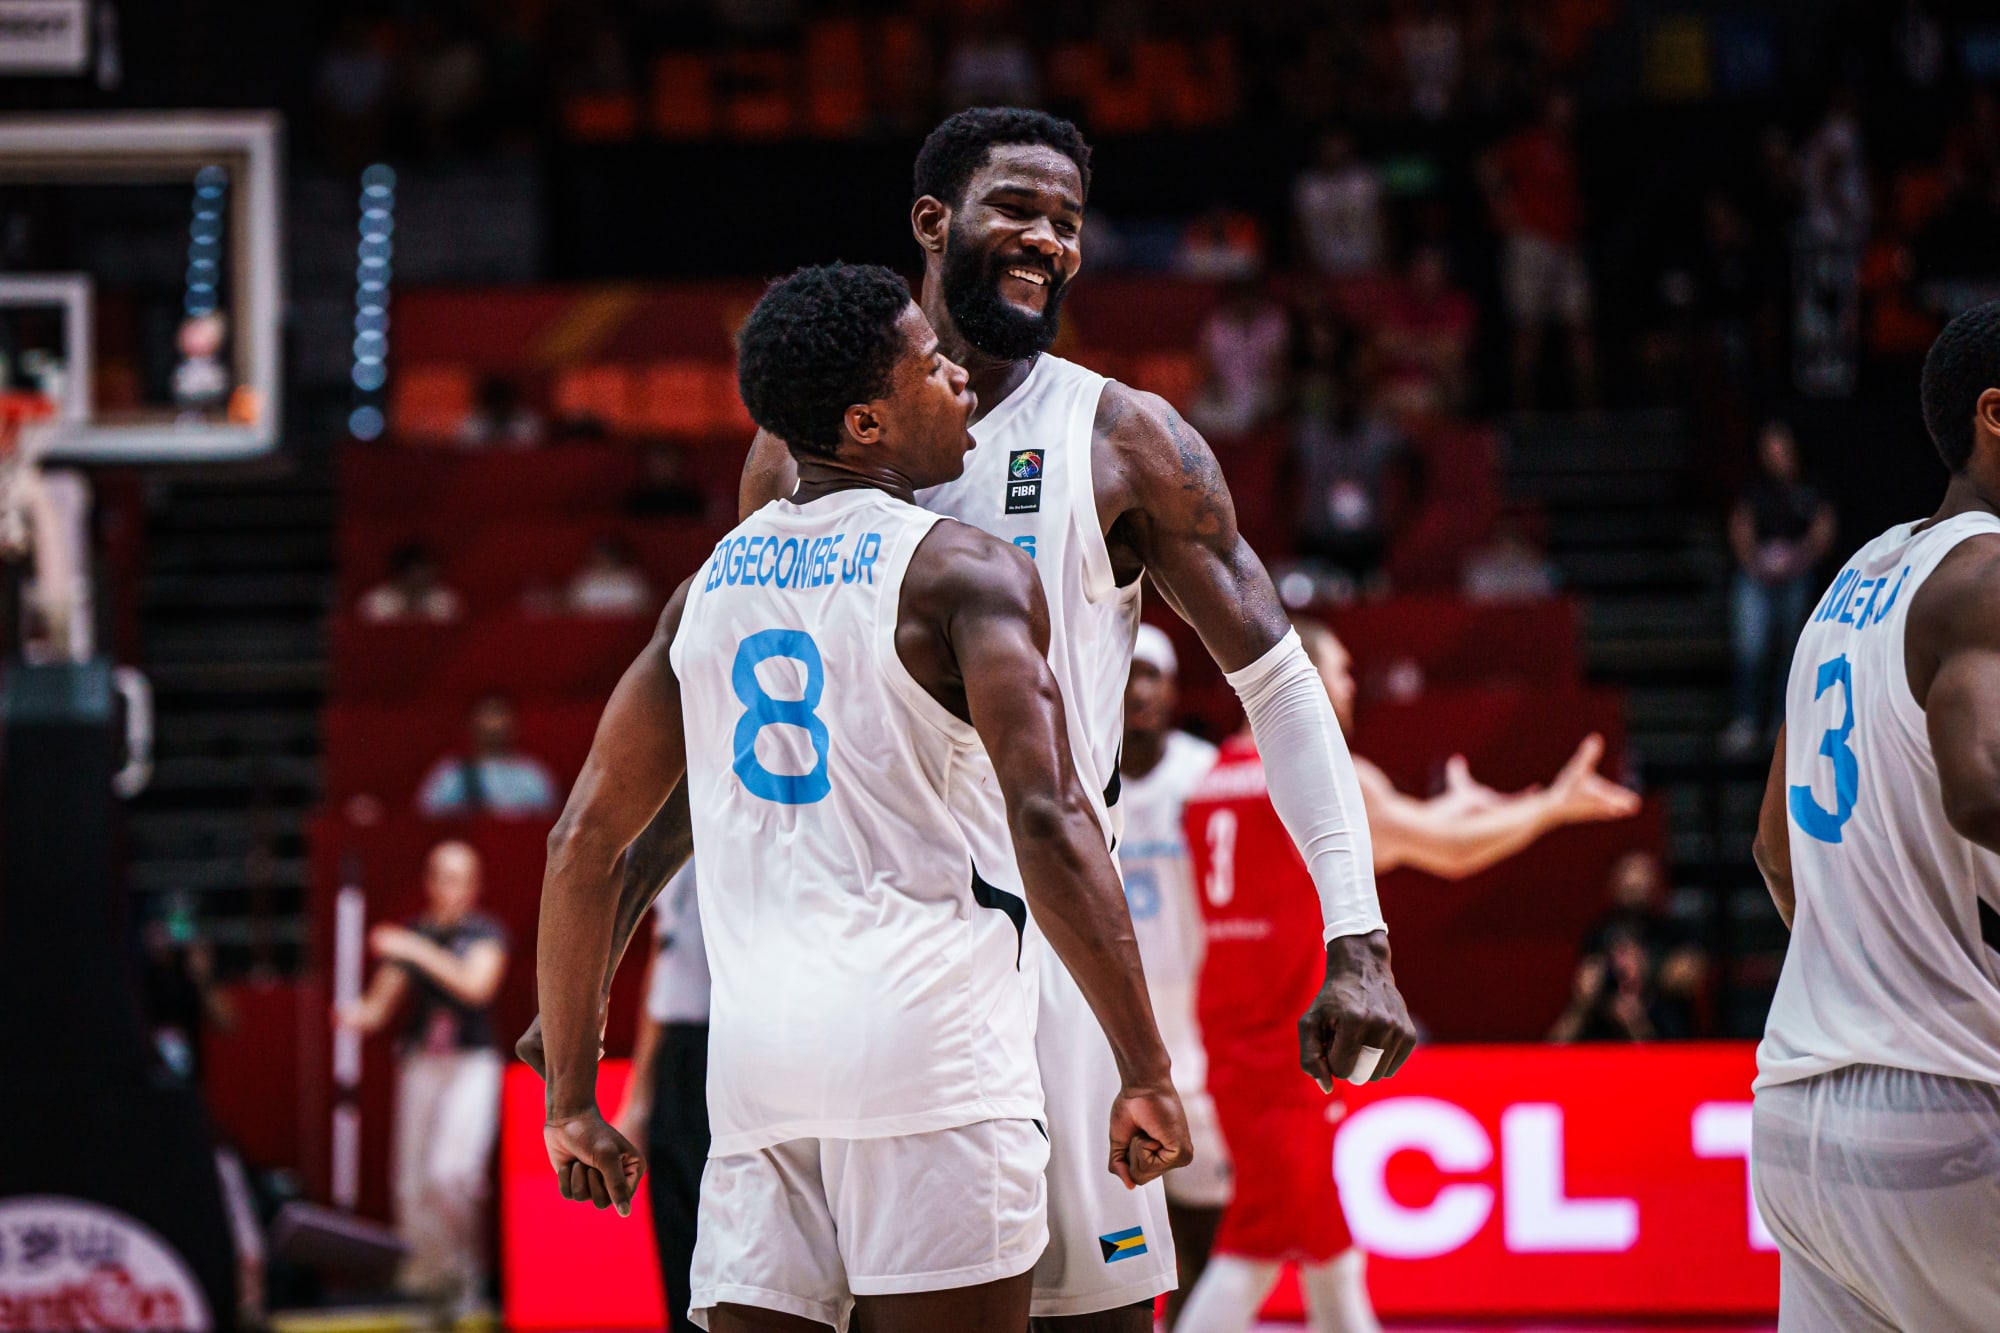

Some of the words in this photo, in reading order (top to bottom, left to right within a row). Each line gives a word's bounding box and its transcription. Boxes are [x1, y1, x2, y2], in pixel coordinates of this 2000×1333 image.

[704, 533, 845, 593] EDGECOMBE
[842, 532, 882, 585] JR
[1011, 485, 1036, 498] FIBA
[731, 628, 832, 805] 8
[1788, 652, 1859, 844] 3
[1332, 1095, 1640, 1260] CL
